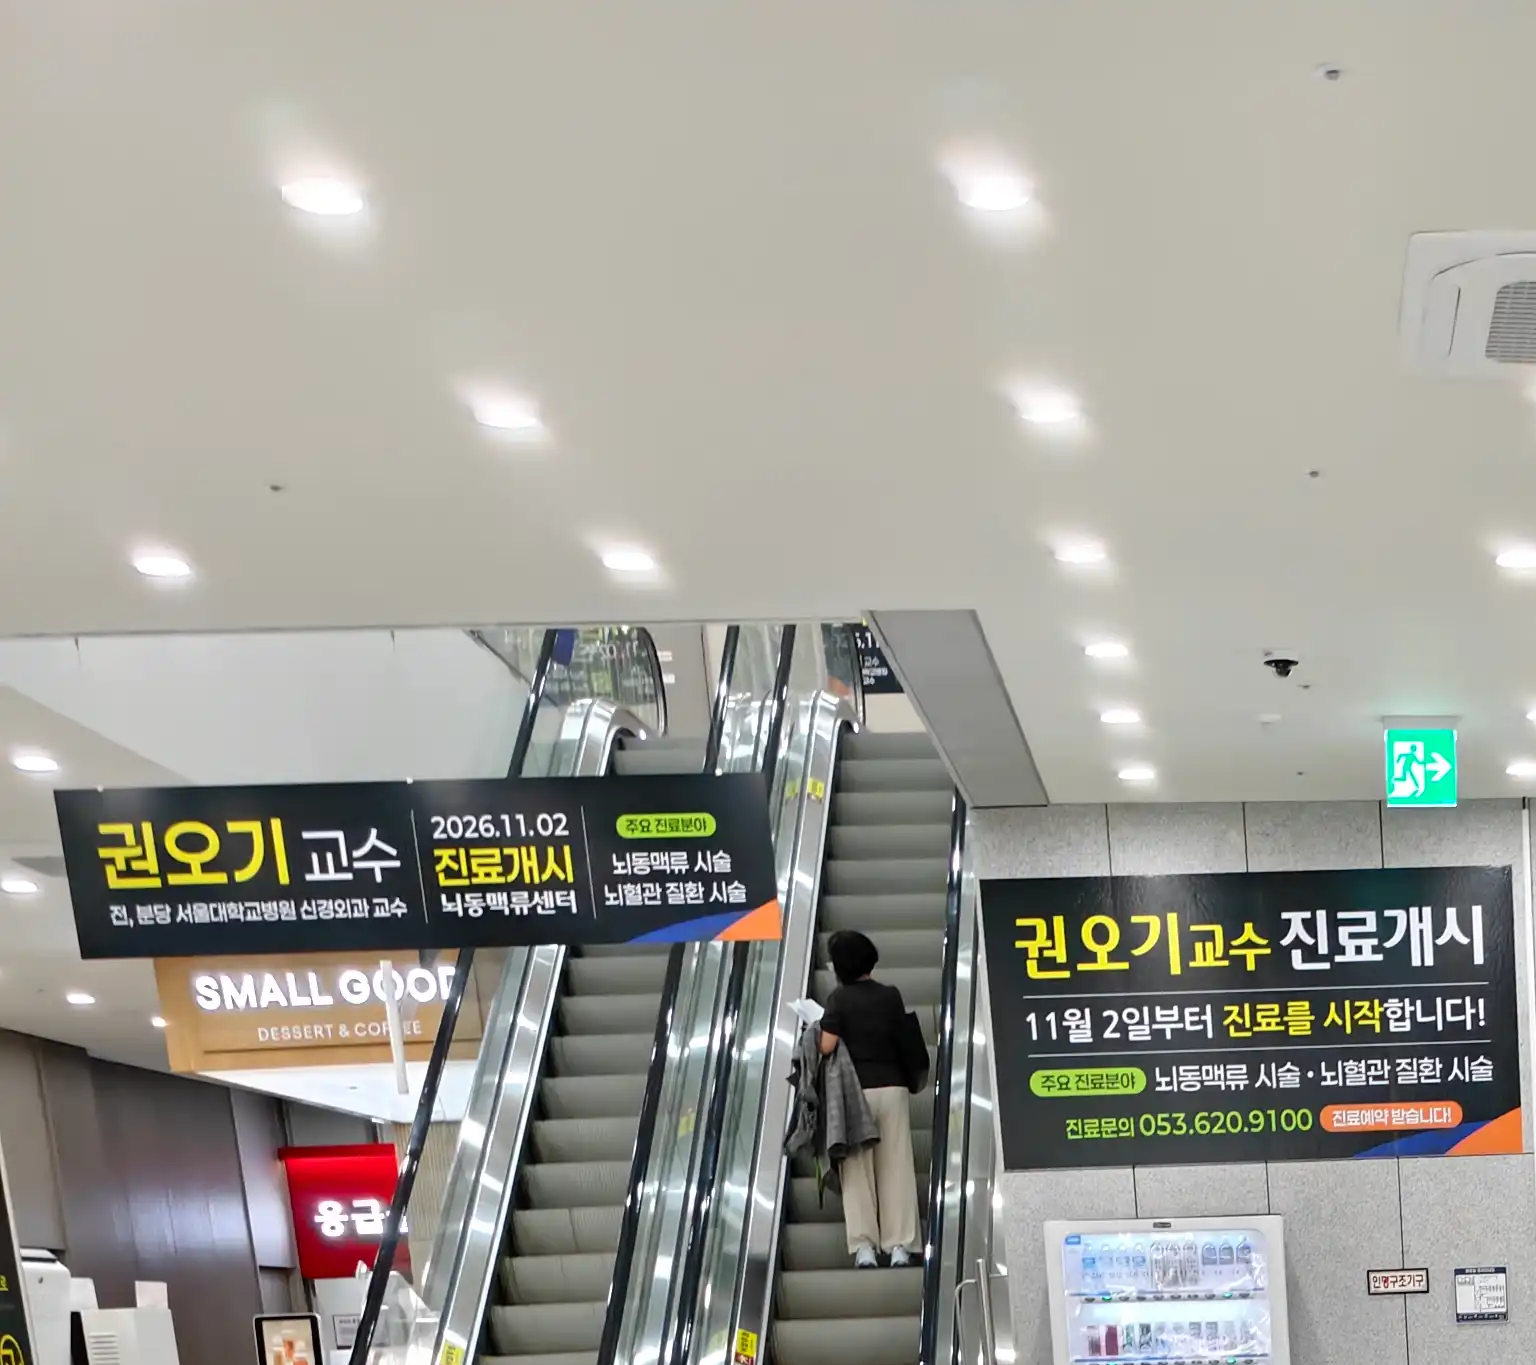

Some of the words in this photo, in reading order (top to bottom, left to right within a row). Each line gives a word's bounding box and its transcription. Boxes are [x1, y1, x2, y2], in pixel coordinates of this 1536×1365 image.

[431, 813, 569, 839] 2026.11.02
[626, 818, 652, 833] 주요
[655, 817, 707, 833] 진료분야
[98, 818, 290, 889] 권오기
[301, 827, 401, 883] 교수
[433, 846, 574, 887] 진료개시
[612, 851, 690, 876] 뇌동맥류
[694, 850, 732, 873] 시술
[440, 890, 578, 917] 뇌동맥류센터
[604, 882, 662, 906] 뇌혈관
[665, 882, 704, 904] 질환
[709, 881, 746, 903] 시술
[109, 906, 134, 928] 전,
[137, 904, 171, 925] 분당
[176, 900, 297, 924] 서울대학교병원
[300, 898, 369, 920] 신경외과
[373, 898, 408, 918] 교수
[1280, 905, 1485, 970] 진료개시
[195, 971, 333, 1010] SMALL
[257, 1024, 333, 1042] DESSERT
[339, 1024, 349, 1038] &
[1026, 1008, 1093, 1043] 11월
[1103, 1004, 1213, 1041] 2일부터
[1223, 1001, 1315, 1037] 진료를
[1324, 996, 1486, 1034] 시작합니다!
[1041, 1075, 1071, 1092] 주요
[1075, 1073, 1135, 1091] 진료분야
[1155, 1063, 1249, 1092] 뇌동맥류
[1255, 1062, 1301, 1089] 시술
[1320, 1060, 1391, 1087] 뇌혈관
[1395, 1057, 1442, 1084] 질환
[1448, 1056, 1494, 1082] 시술
[1066, 1117, 1135, 1140] 진료문의
[1139, 1109, 1312, 1137] 053.620.9100
[1332, 1109, 1389, 1128] 진료예약
[1391, 1108, 1452, 1125] 받습니다!
[314, 1199, 409, 1238] 응급
[1371, 1274, 1425, 1289] 인명구조기구
